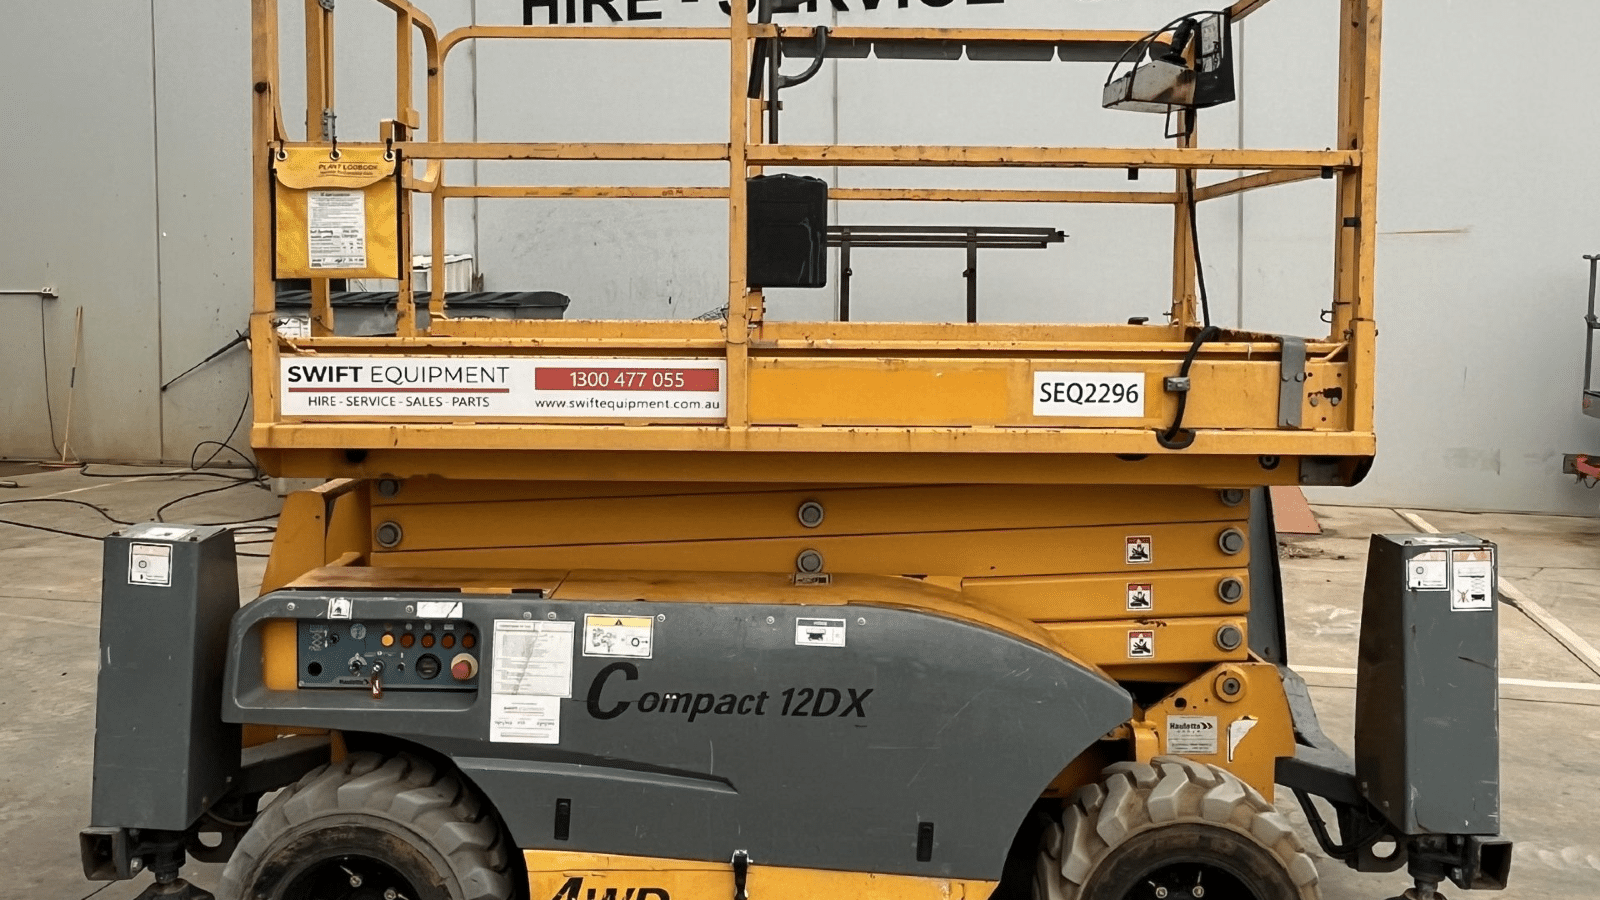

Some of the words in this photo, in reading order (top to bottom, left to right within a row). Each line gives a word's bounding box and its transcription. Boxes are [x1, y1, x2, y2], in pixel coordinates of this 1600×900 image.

[288, 366, 363, 383] SWIFT
[370, 366, 510, 386] EQUIPMENT
[569, 371, 610, 387] 1300
[613, 372, 648, 387] 477
[652, 372, 685, 388] 055
[308, 396, 337, 407] HIRE
[346, 396, 396, 407] SERVICE
[406, 396, 443, 407] SALES
[452, 396, 490, 407] PARTS
[1039, 382, 1139, 405] SEQ2296
[535, 397, 720, 411] www.swiftequipment.com.au
[586, 661, 769, 722] Compact
[781, 687, 874, 718] 12DX
